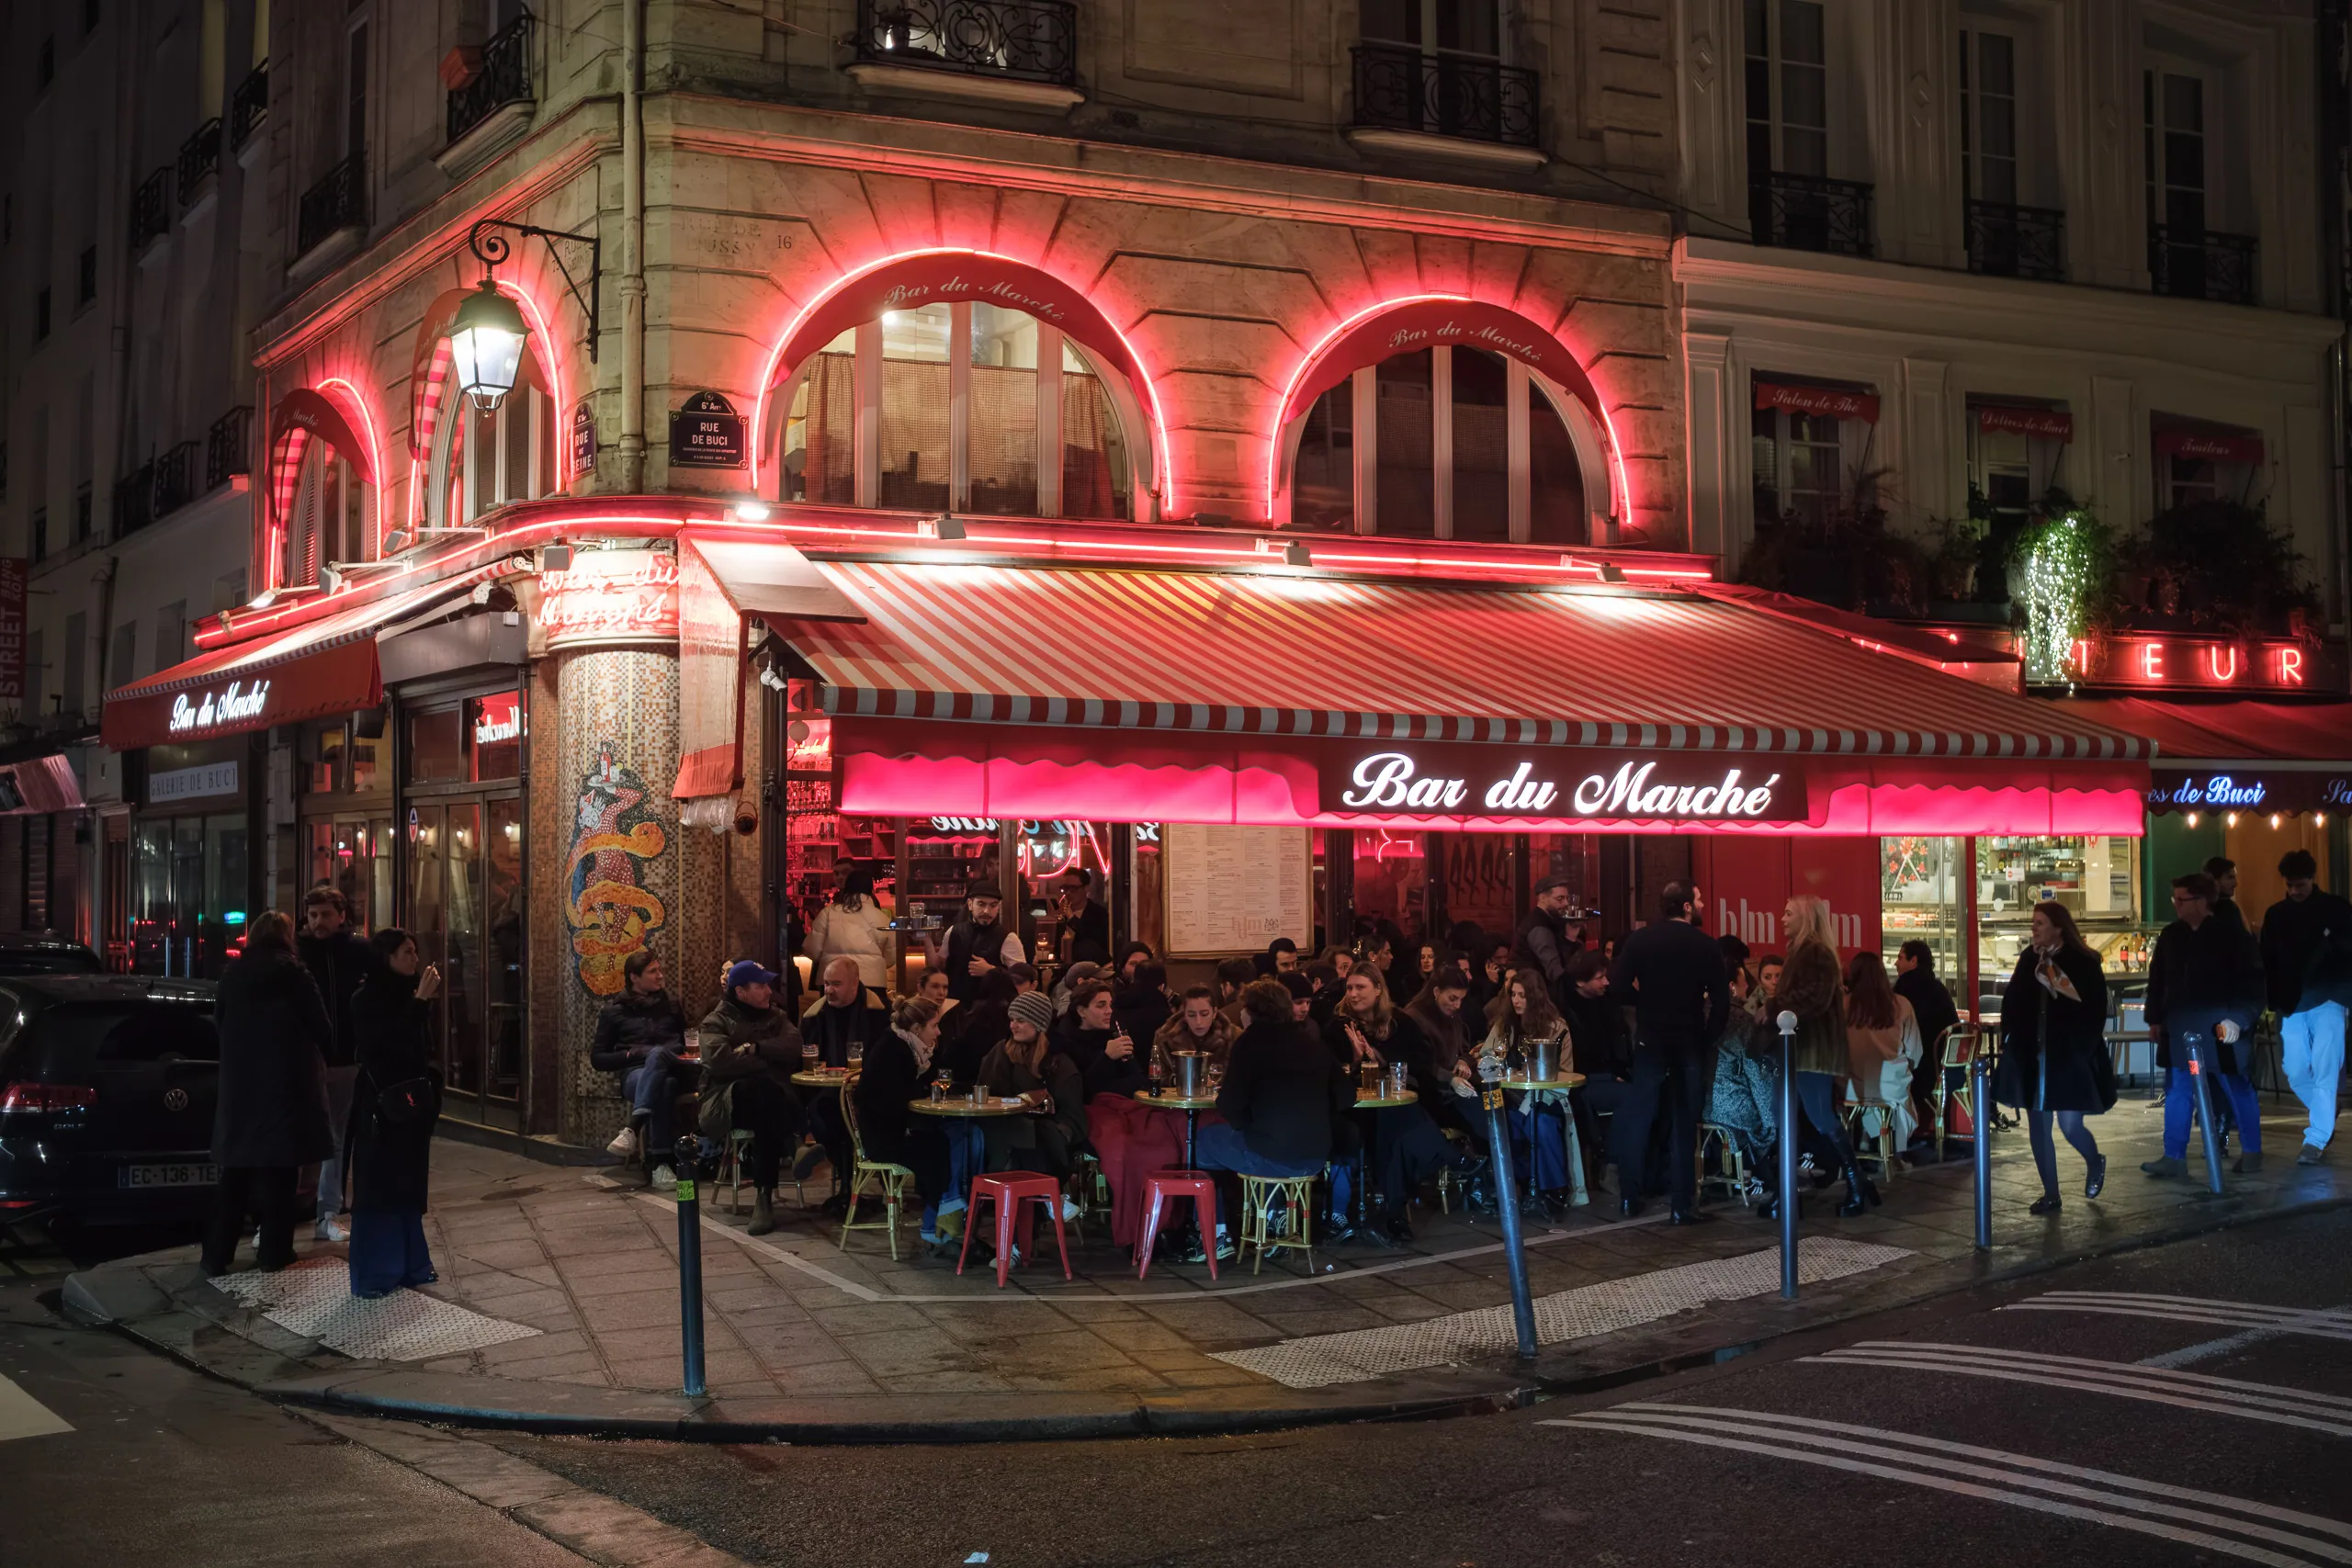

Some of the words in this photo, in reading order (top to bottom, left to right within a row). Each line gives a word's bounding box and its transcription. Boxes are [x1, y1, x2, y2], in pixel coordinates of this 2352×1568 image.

[777, 234, 793, 250] 16
[884, 285, 930, 305] Bar
[940, 276, 969, 292] du
[978, 281, 1065, 320] Marché
[1388, 329, 1428, 348] Bar
[1437, 321, 1462, 336] du
[1469, 326, 1541, 361] Marché
[1772, 389, 1812, 408] Salon
[1815, 396, 1830, 410] de
[1834, 396, 1860, 412] Thé
[574, 430, 589, 447] RUE
[692, 434, 705, 446] DE
[706, 435, 728, 446] BUCI
[700, 423, 719, 433] RUE
[0, 605, 21, 695] STREET
[169, 694, 196, 731] Bar
[197, 692, 215, 727] du
[216, 680, 271, 725] Marché
[151, 775, 185, 797] GALERIE
[189, 773, 202, 791] DE
[1342, 752, 1467, 808] Bar
[1485, 761, 1558, 810] du
[1574, 761, 1781, 816] Marché
[2173, 778, 2203, 804] de
[2206, 775, 2266, 804] Buci
